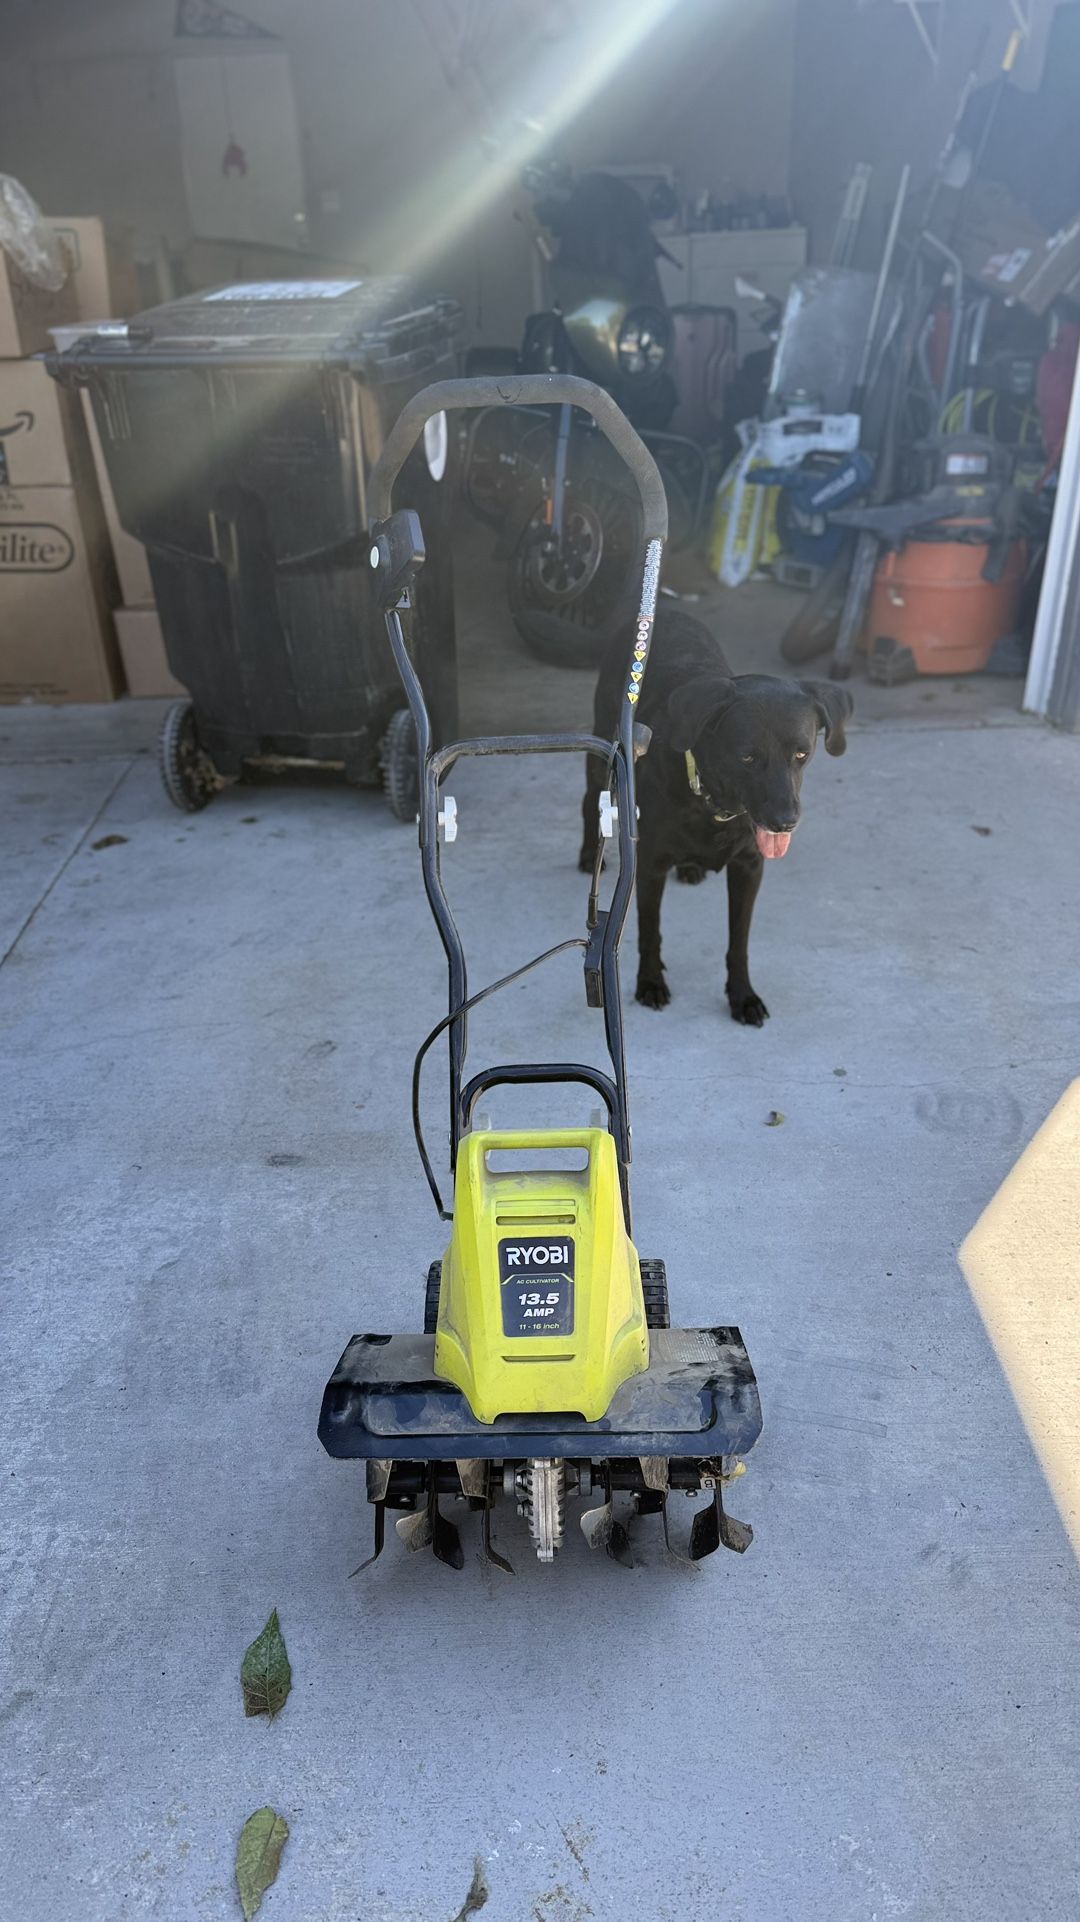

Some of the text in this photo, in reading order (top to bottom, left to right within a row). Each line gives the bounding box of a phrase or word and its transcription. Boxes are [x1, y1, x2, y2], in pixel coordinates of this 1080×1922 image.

[0, 533, 56, 563] ilite
[505, 1245, 569, 1266] RYOBI
[518, 1292, 560, 1306] 13.5
[523, 1307, 555, 1318] AMP
